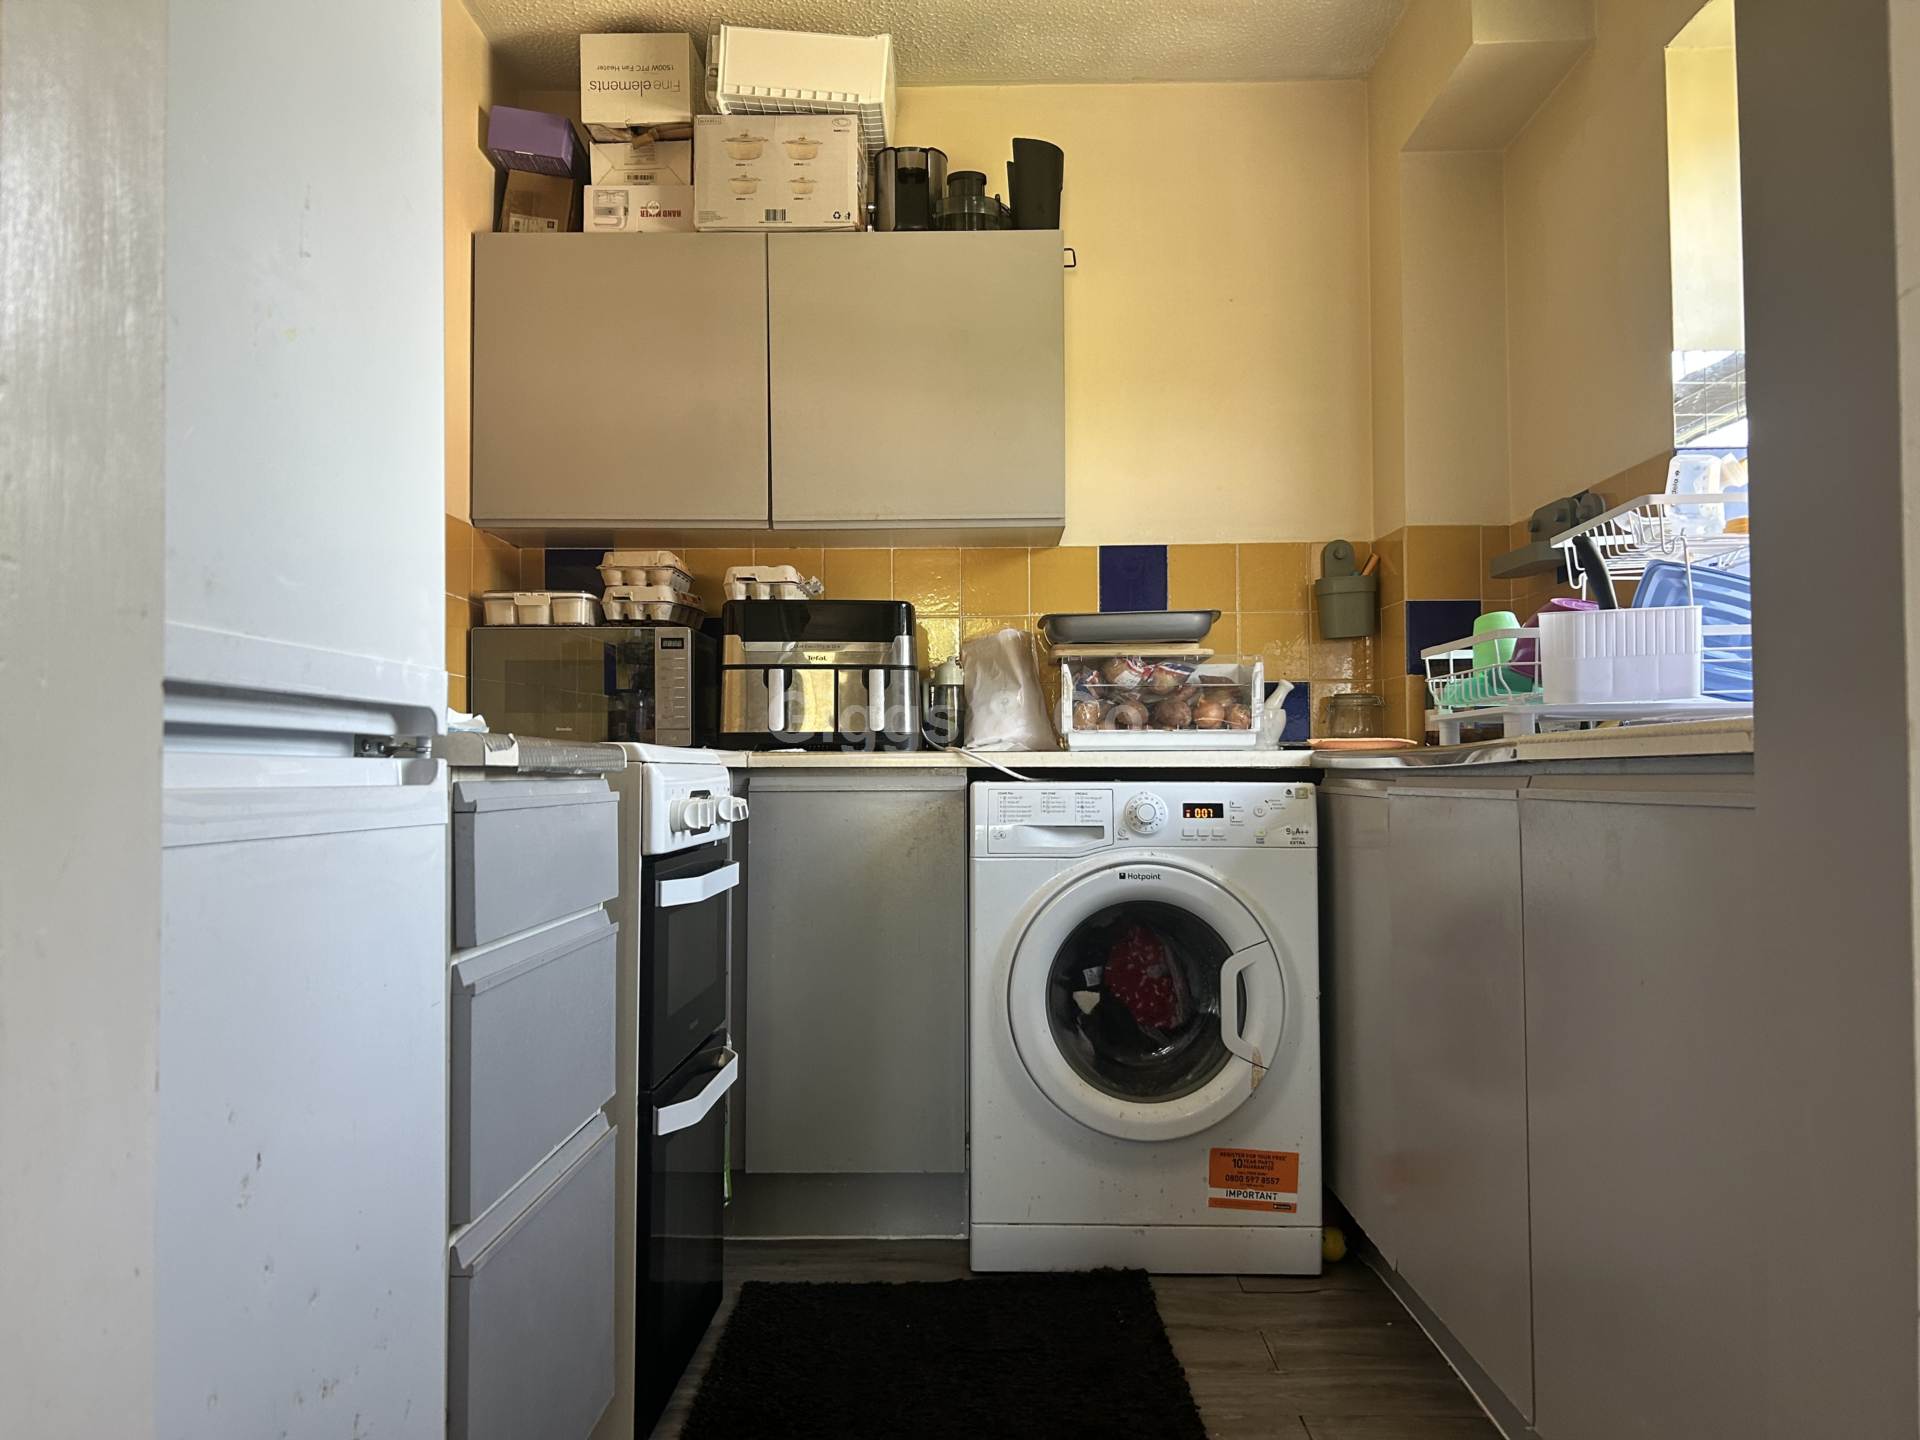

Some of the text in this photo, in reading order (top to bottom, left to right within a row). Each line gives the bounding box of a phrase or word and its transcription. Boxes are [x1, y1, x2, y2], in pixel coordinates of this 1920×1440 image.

[596, 64, 674, 72] 1500W PTC Fan Heater
[662, 210, 682, 218] HAND
[1127, 872, 1161, 881] Hotpoint
[1231, 1158, 1243, 1169] 10
[1225, 1174, 1244, 1183] 0800
[1225, 1189, 1278, 1201] IMPORTANT
